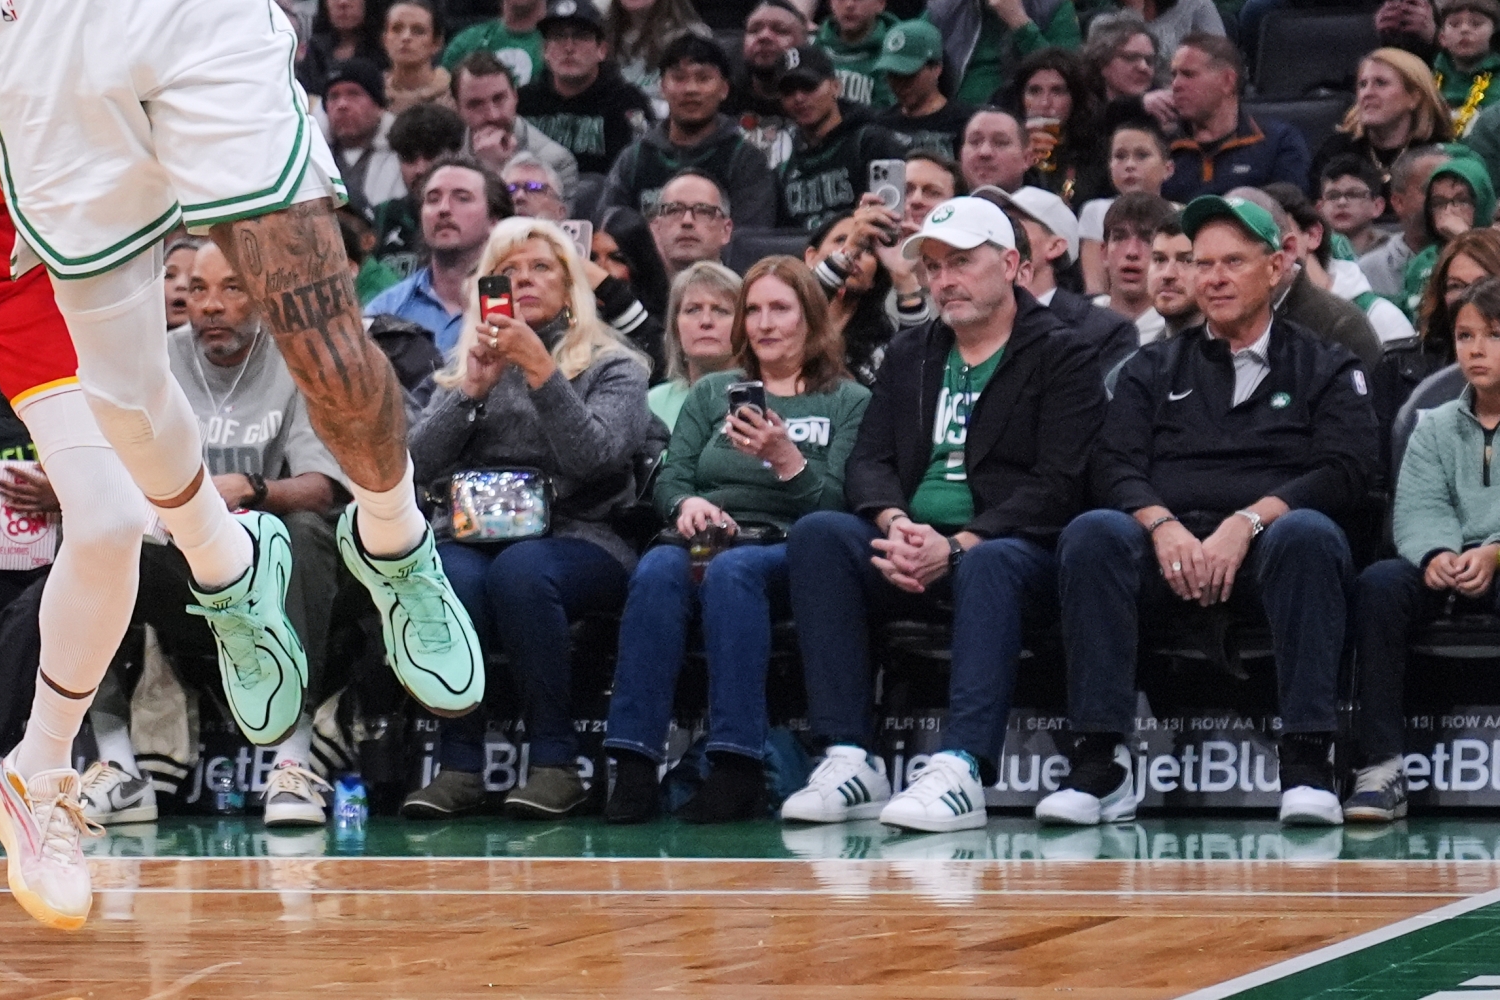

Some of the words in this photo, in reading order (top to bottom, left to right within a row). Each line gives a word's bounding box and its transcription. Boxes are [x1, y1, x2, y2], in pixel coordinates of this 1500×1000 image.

[834, 69, 874, 105] TON
[207, 416, 240, 445] OF
[885, 717, 914, 730] FLR
[1026, 717, 1066, 730] SEAT
[1191, 717, 1230, 730] ROW
[1234, 717, 1255, 730] AA
[1442, 716, 1480, 729] ROW
[186, 744, 279, 804] jetB
[1132, 741, 1282, 801] jetBlu
[1404, 740, 1500, 792] etBl
